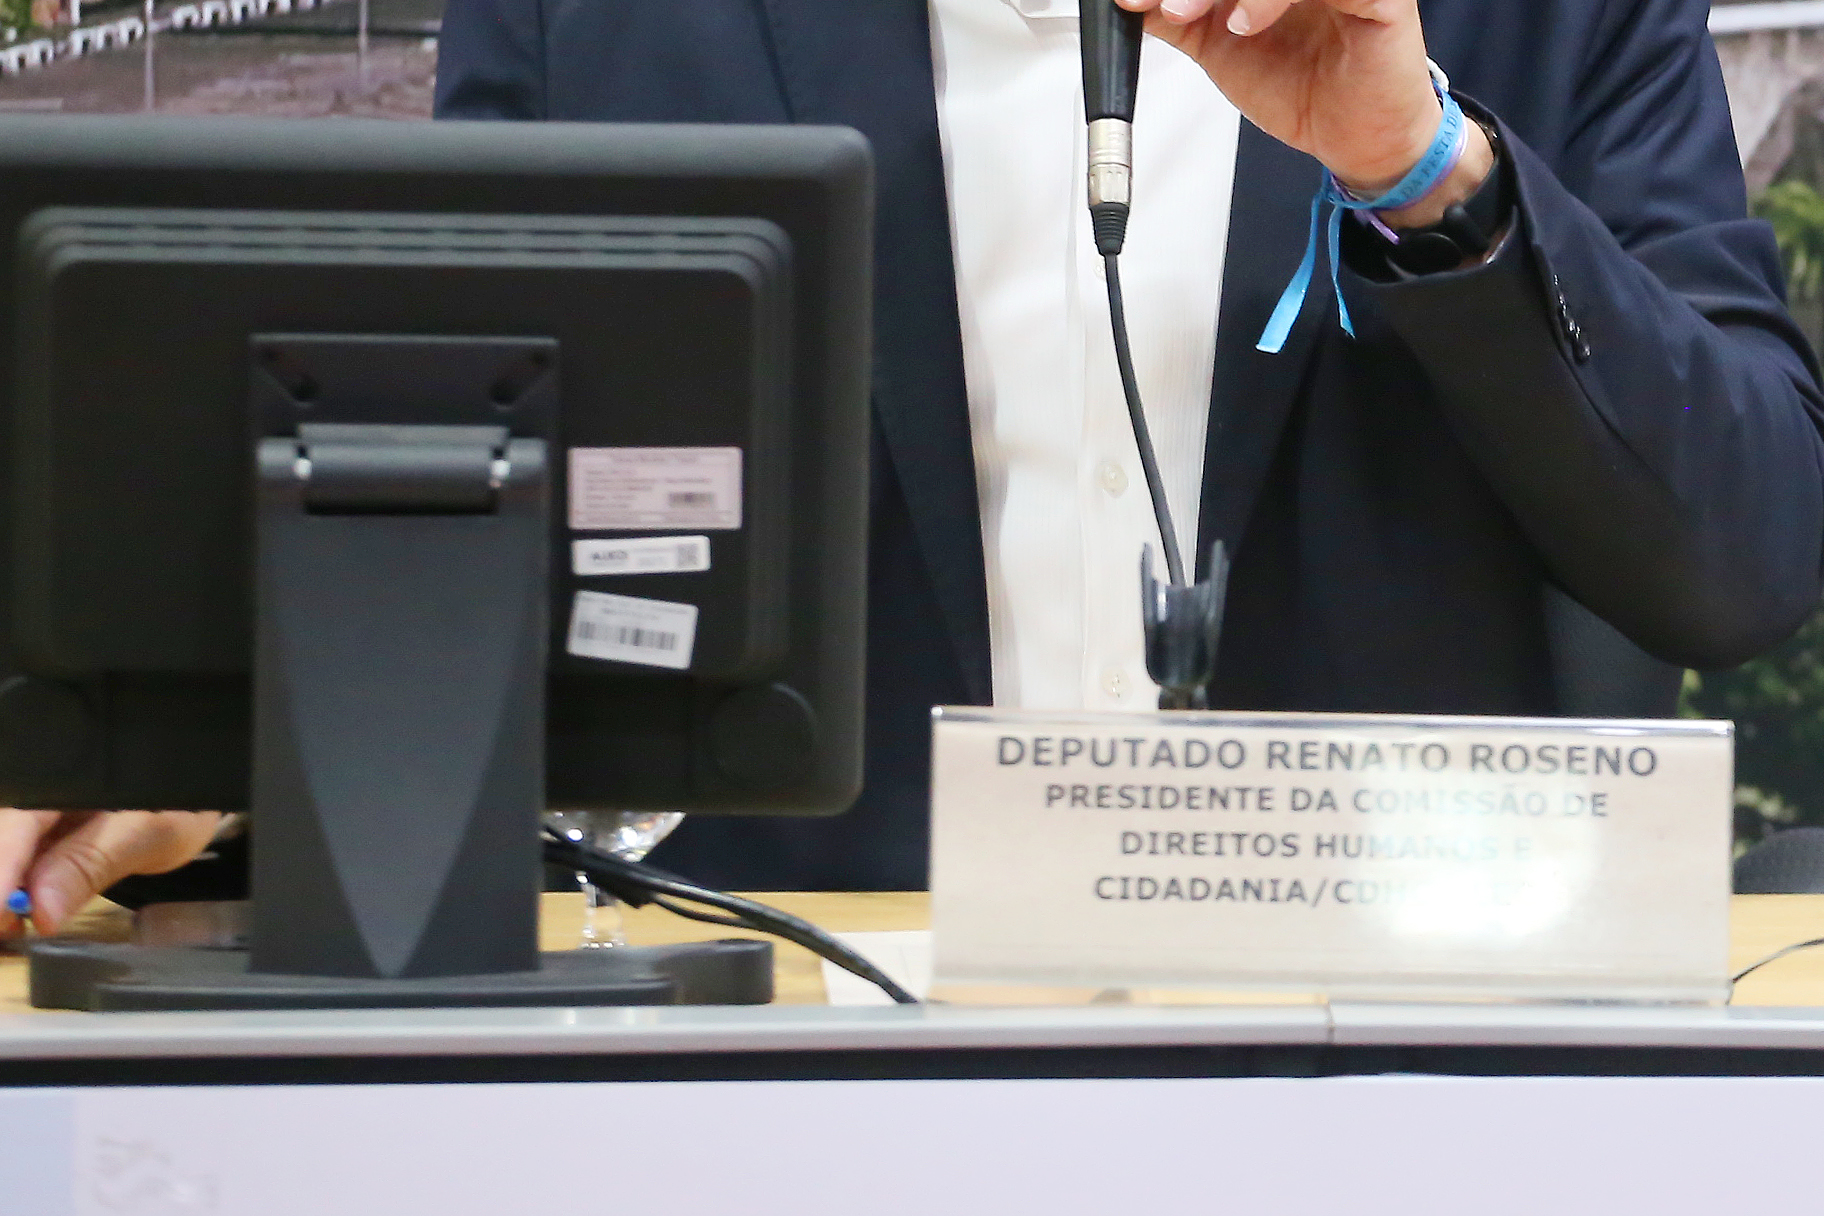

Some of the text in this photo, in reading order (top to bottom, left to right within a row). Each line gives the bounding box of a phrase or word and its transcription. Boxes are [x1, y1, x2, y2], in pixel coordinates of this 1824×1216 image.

[1421, 130, 1454, 177] FESTA
[998, 737, 1657, 776] DEPUTADO RENATO ROSENO
[1046, 783, 1608, 817] PRESIDENTE DA COMISSÃO DE
[1121, 831, 1532, 862] DIREITOS HUMANOS E
